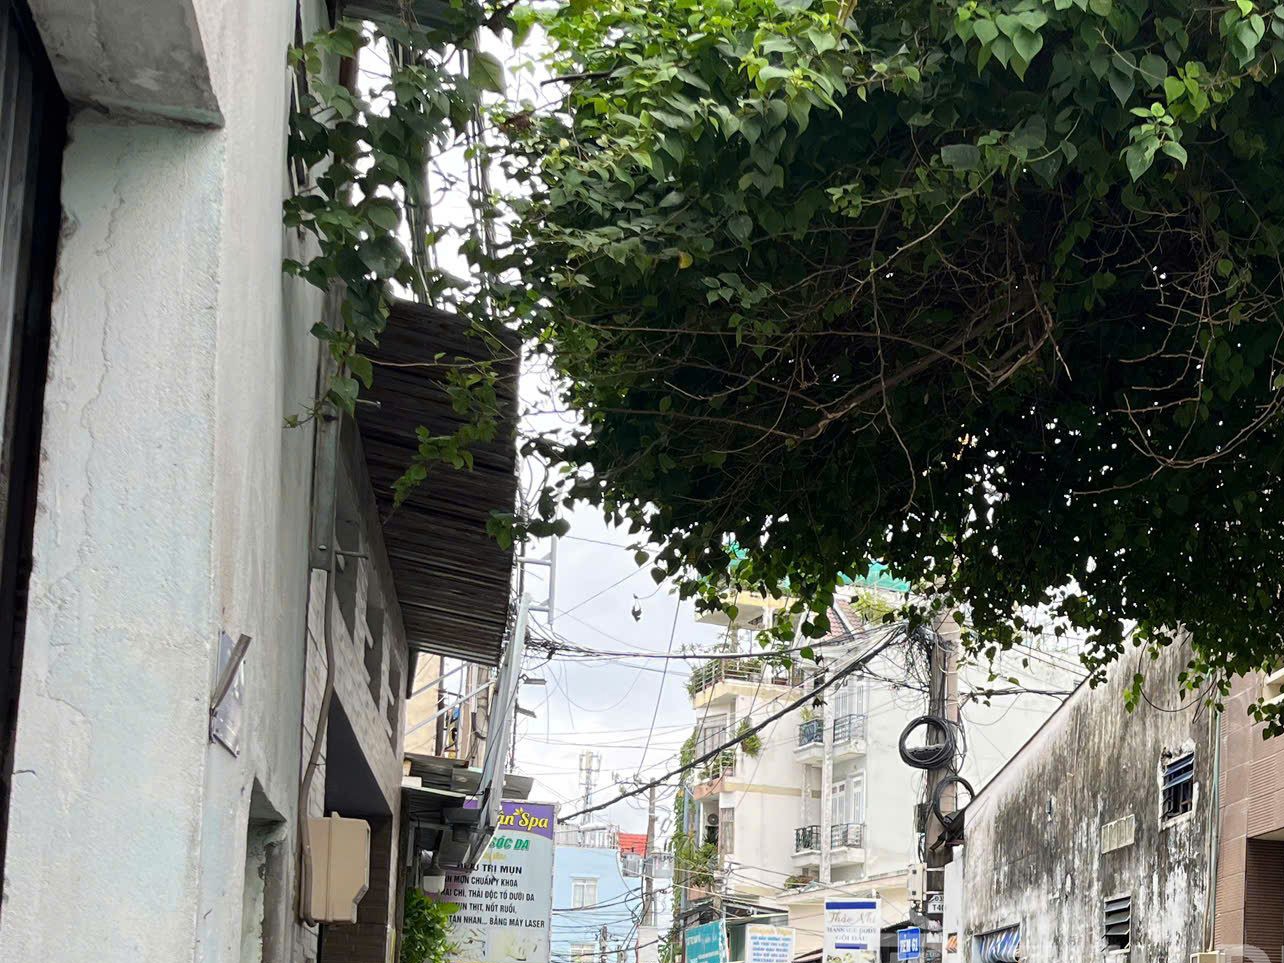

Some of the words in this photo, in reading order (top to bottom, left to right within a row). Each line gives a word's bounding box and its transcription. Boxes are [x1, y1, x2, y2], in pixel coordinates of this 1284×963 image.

[518, 812, 549, 832] Spa
[499, 865, 522, 876] MỤN
[500, 879, 518, 888] KHOA
[524, 919, 545, 928] LASER
